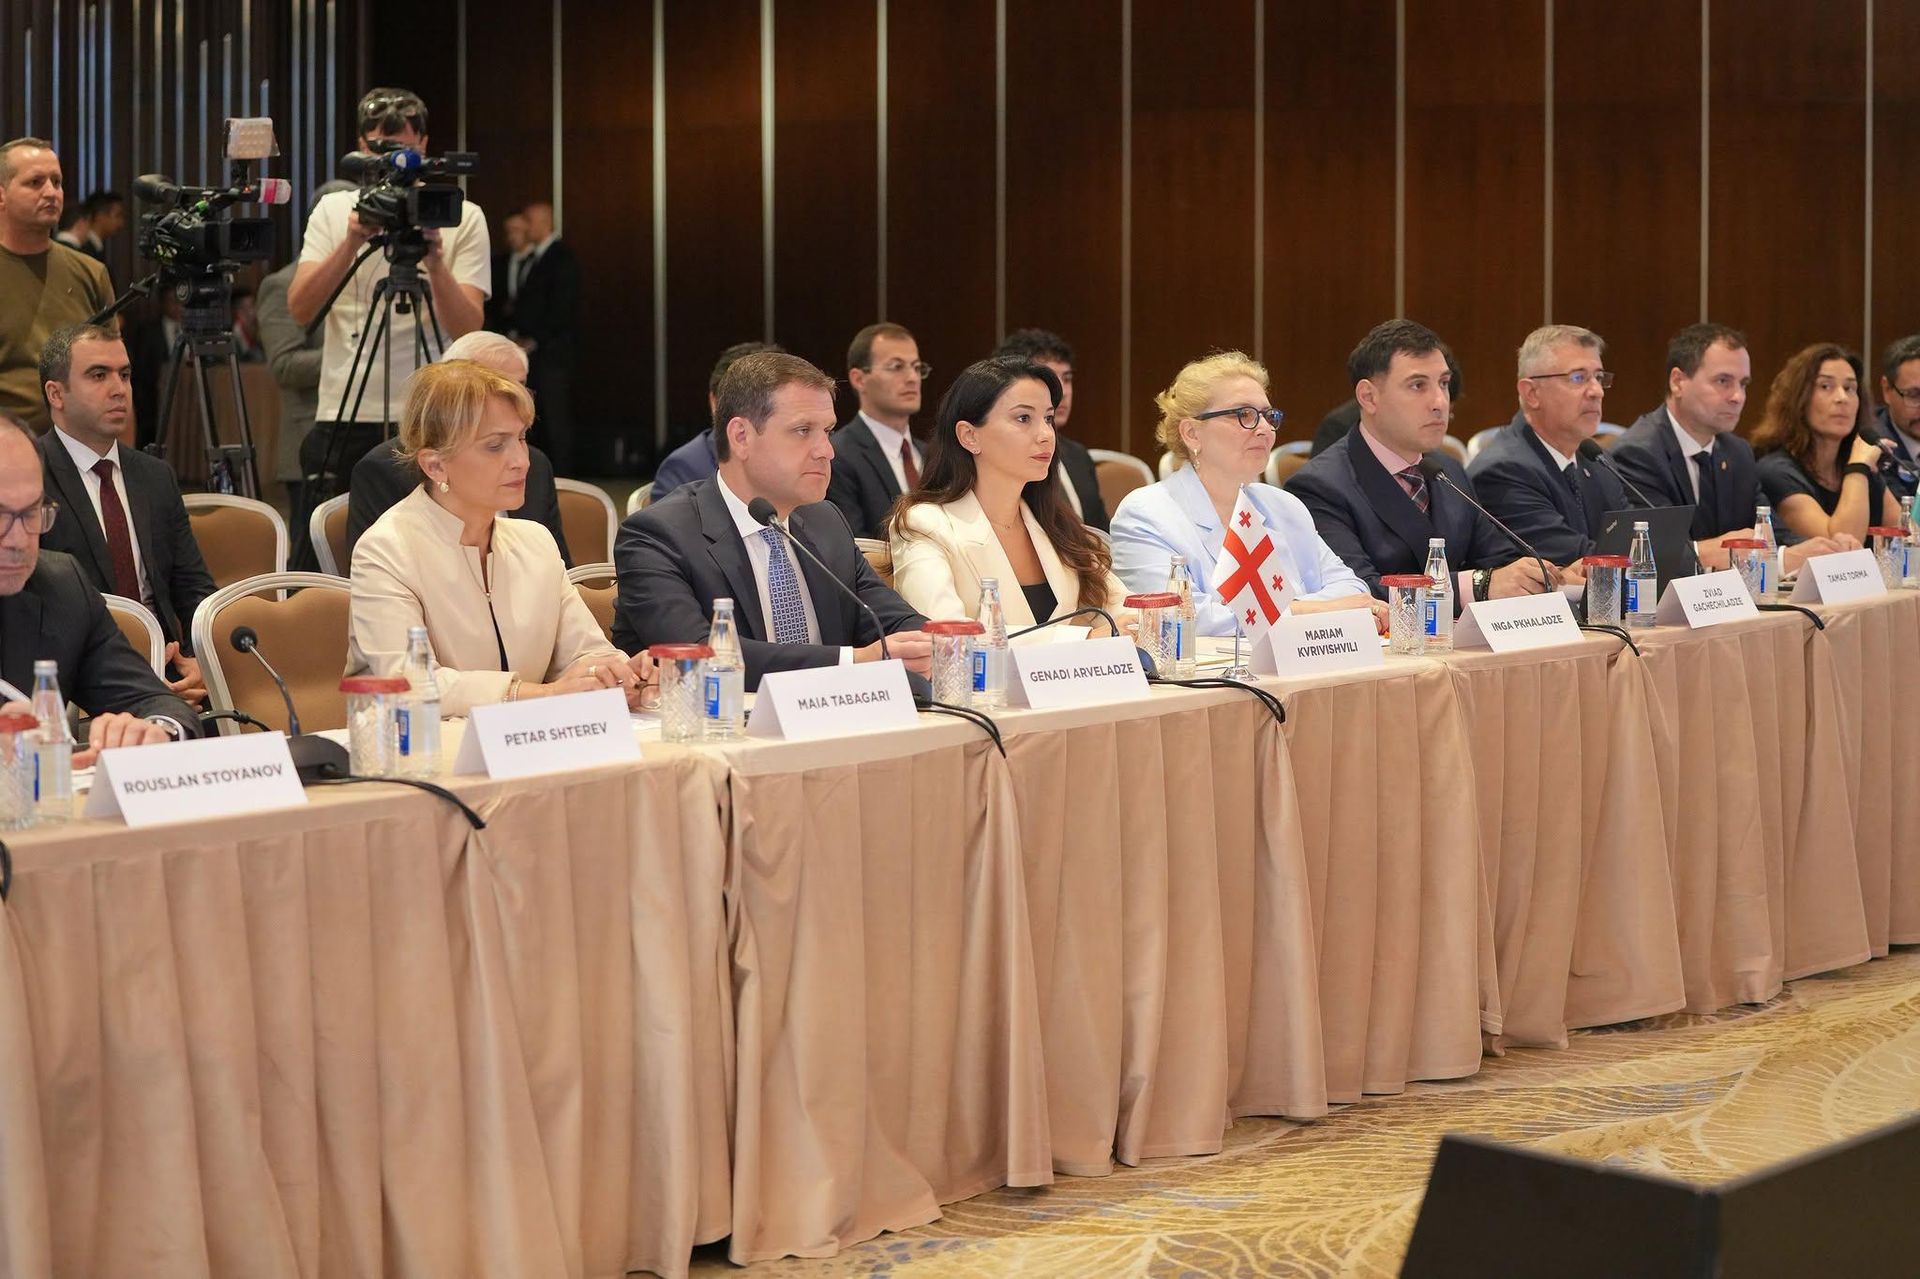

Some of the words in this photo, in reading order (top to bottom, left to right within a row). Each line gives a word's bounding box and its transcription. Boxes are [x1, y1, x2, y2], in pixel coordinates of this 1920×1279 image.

[1827, 573, 1848, 583] TAMAS
[1848, 570, 1868, 580] TORMA
[1703, 588, 1723, 598] ZVIAD
[1693, 597, 1744, 612] GACHECHILADZE
[1491, 621, 1514, 632] INGA
[1514, 614, 1564, 629] PKHALADZE
[1305, 628, 1344, 641] MARIAM
[1297, 642, 1358, 657] KVRIVISHVILI
[1030, 668, 1070, 682] GENADI
[1073, 663, 1135, 678] ARVELADZE
[798, 698, 829, 710] MAIA
[831, 690, 890, 706] TABAGARI
[505, 730, 547, 746] PETAR
[550, 723, 608, 740] SHTEREV
[123, 774, 199, 793] ROUSLAN
[203, 763, 283, 783] STOYANOV
